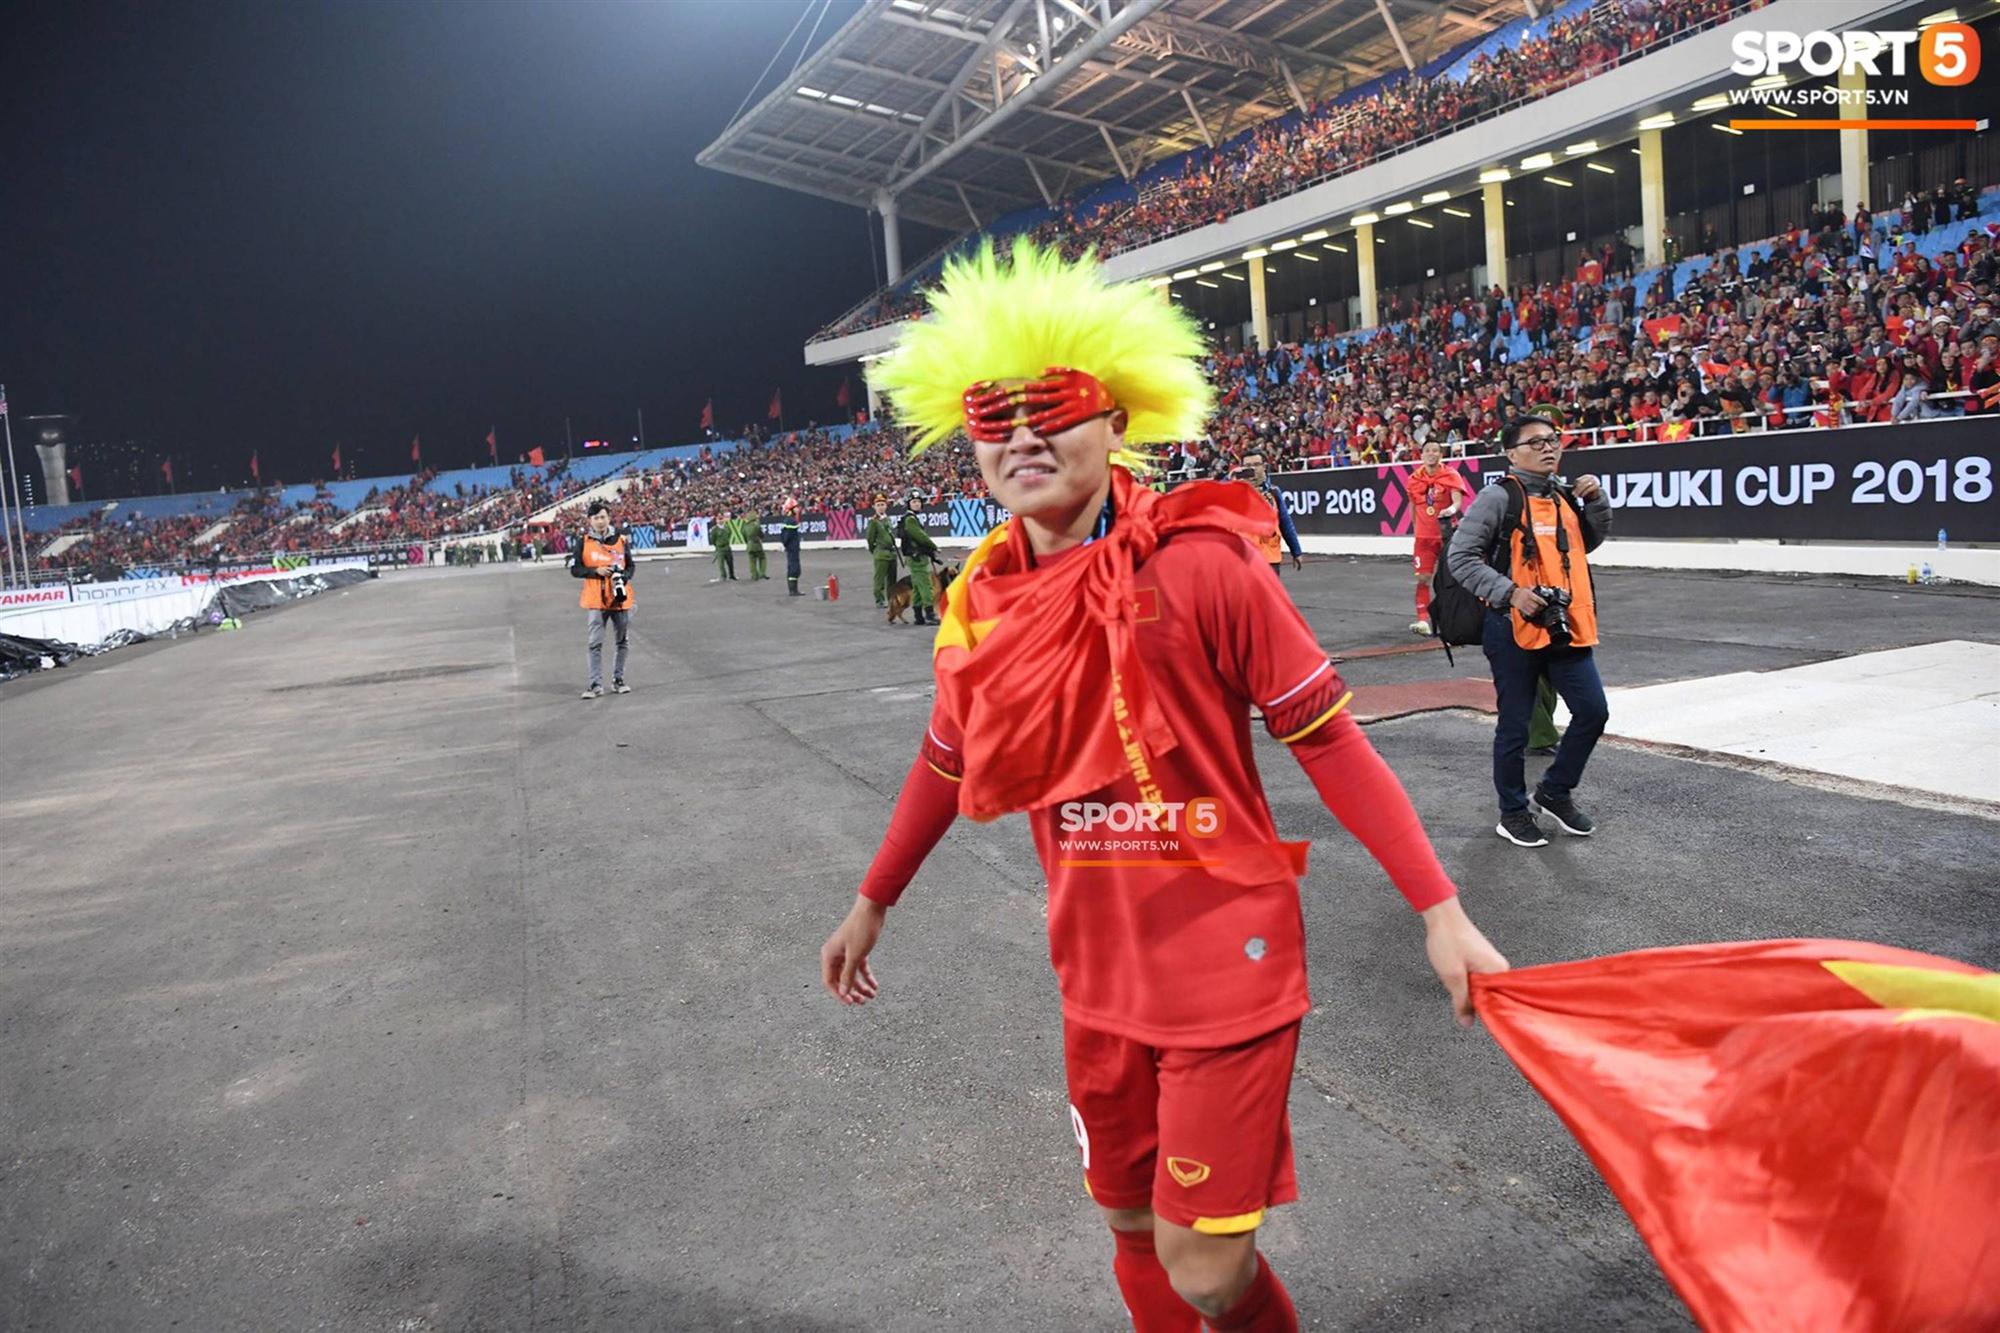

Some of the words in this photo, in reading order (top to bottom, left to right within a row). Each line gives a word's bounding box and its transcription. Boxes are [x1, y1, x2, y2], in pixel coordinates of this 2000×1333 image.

[1735, 463, 1836, 507] CUP
[1851, 456, 1993, 504] 2018
[1281, 490, 1321, 515] CUP
[1325, 487, 1377, 515] 2018
[928, 512, 950, 527] 2018
[0, 590, 65, 605] ANMAR
